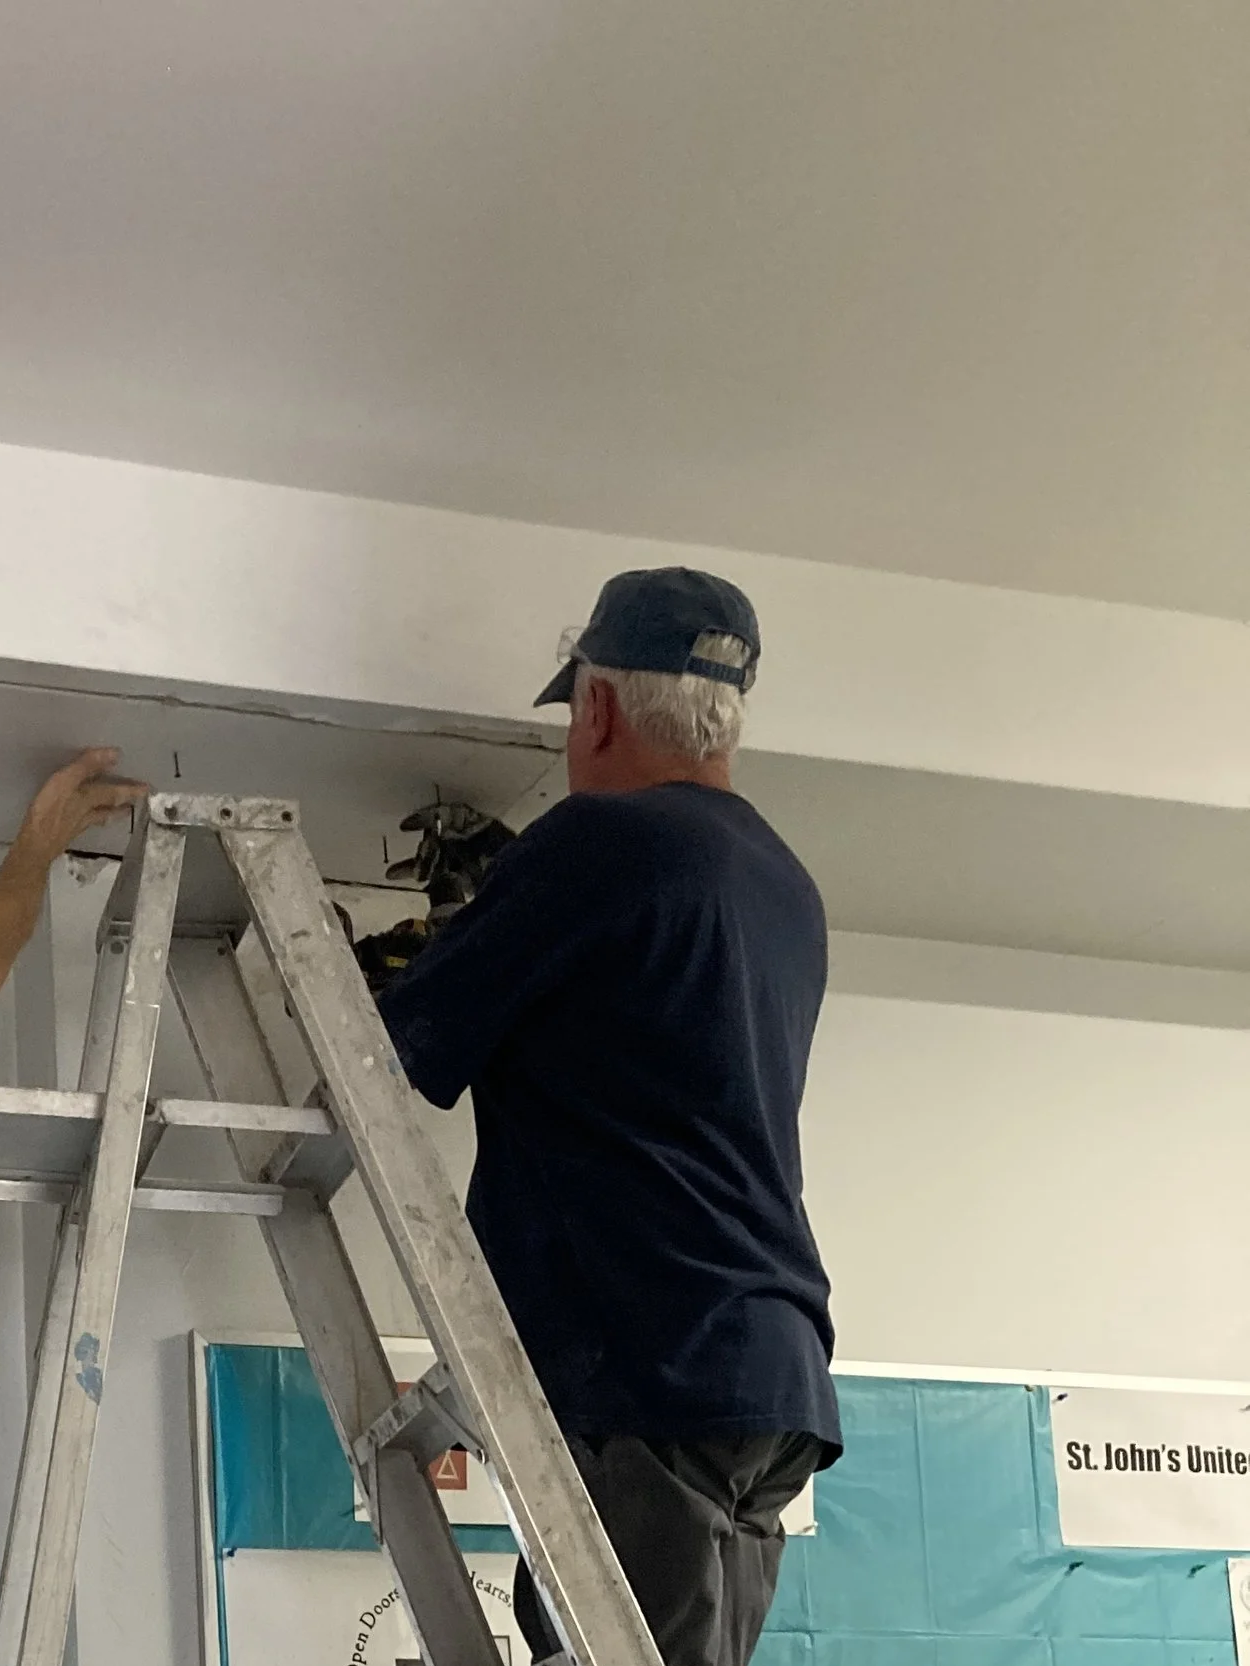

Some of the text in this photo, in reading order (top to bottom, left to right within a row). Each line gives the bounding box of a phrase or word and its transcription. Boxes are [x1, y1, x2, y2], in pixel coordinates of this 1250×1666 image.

[1066, 1441, 1250, 1475] St. John's Unite
